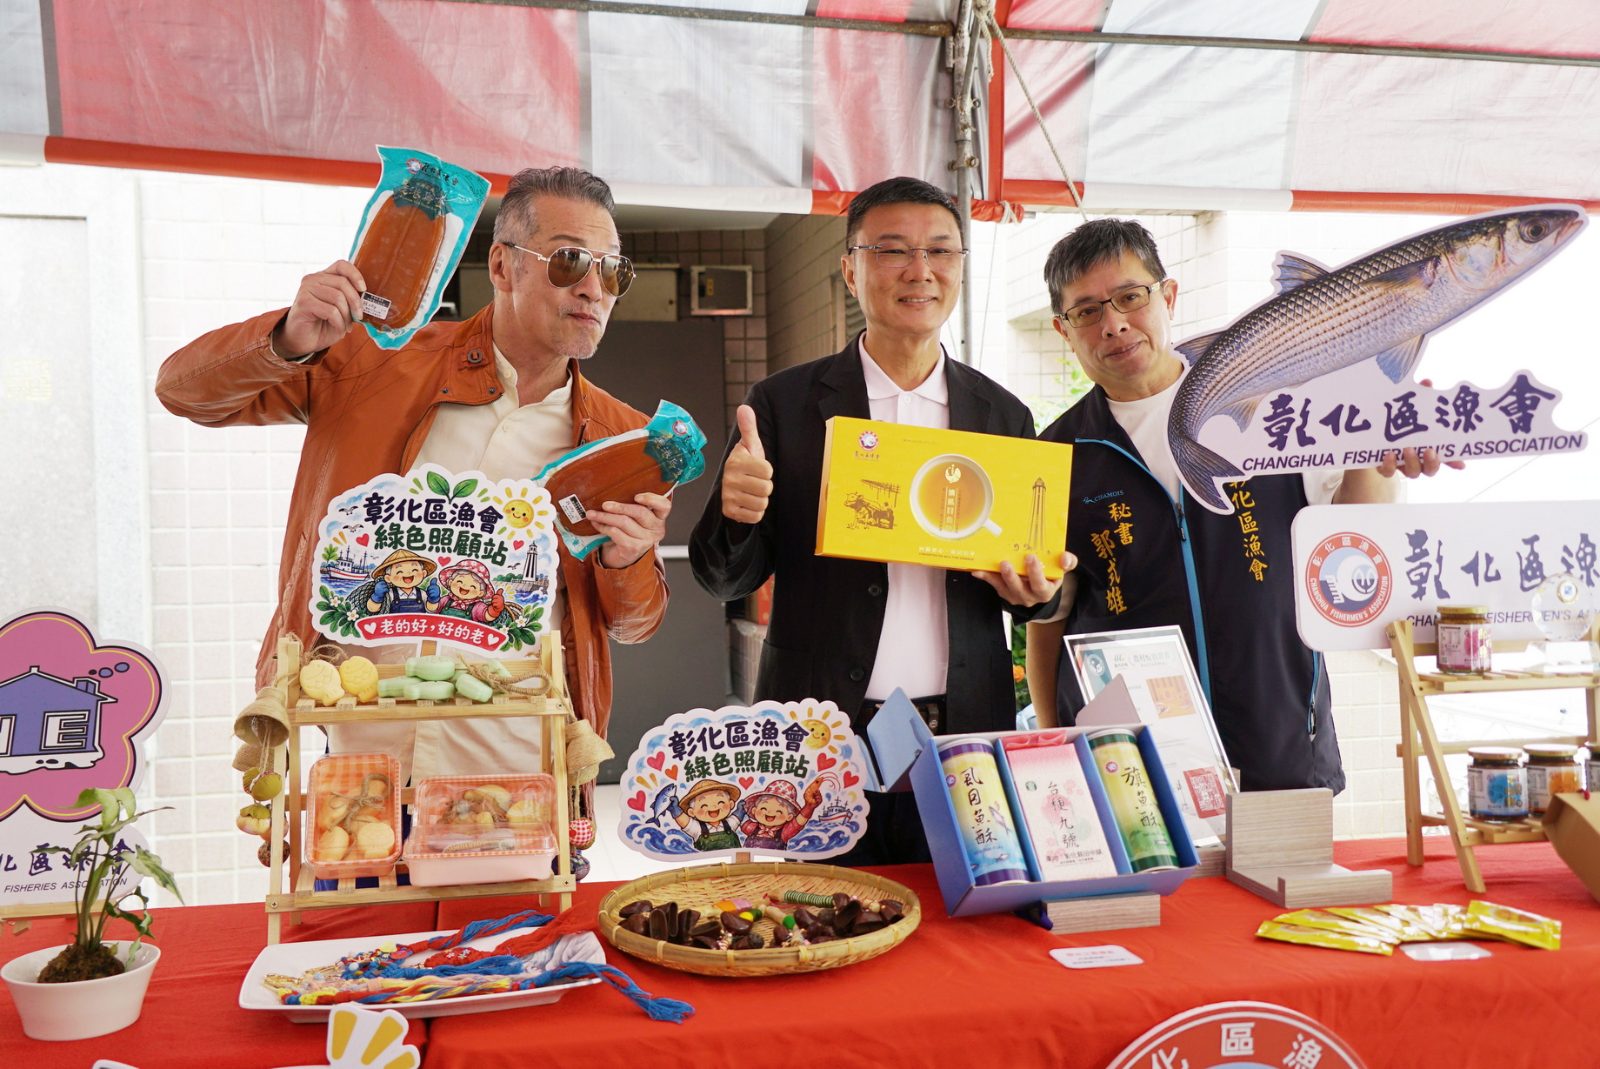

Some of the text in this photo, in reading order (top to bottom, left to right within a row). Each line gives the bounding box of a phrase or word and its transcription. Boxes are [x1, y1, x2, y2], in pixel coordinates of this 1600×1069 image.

[1263, 374, 1557, 451] 彰化區漁會
[1242, 452, 1335, 471] CHANGHUA
[1460, 434, 1584, 457] ASSOCIATION
[363, 492, 504, 535] 彰化區漁會
[1108, 502, 1133, 546] 秘書
[374, 522, 508, 567] 綠色照顧站
[667, 718, 810, 761] 彰化區漁會
[684, 749, 810, 783] 綠色照顧站
[4, 882, 57, 893] FISHERIES
